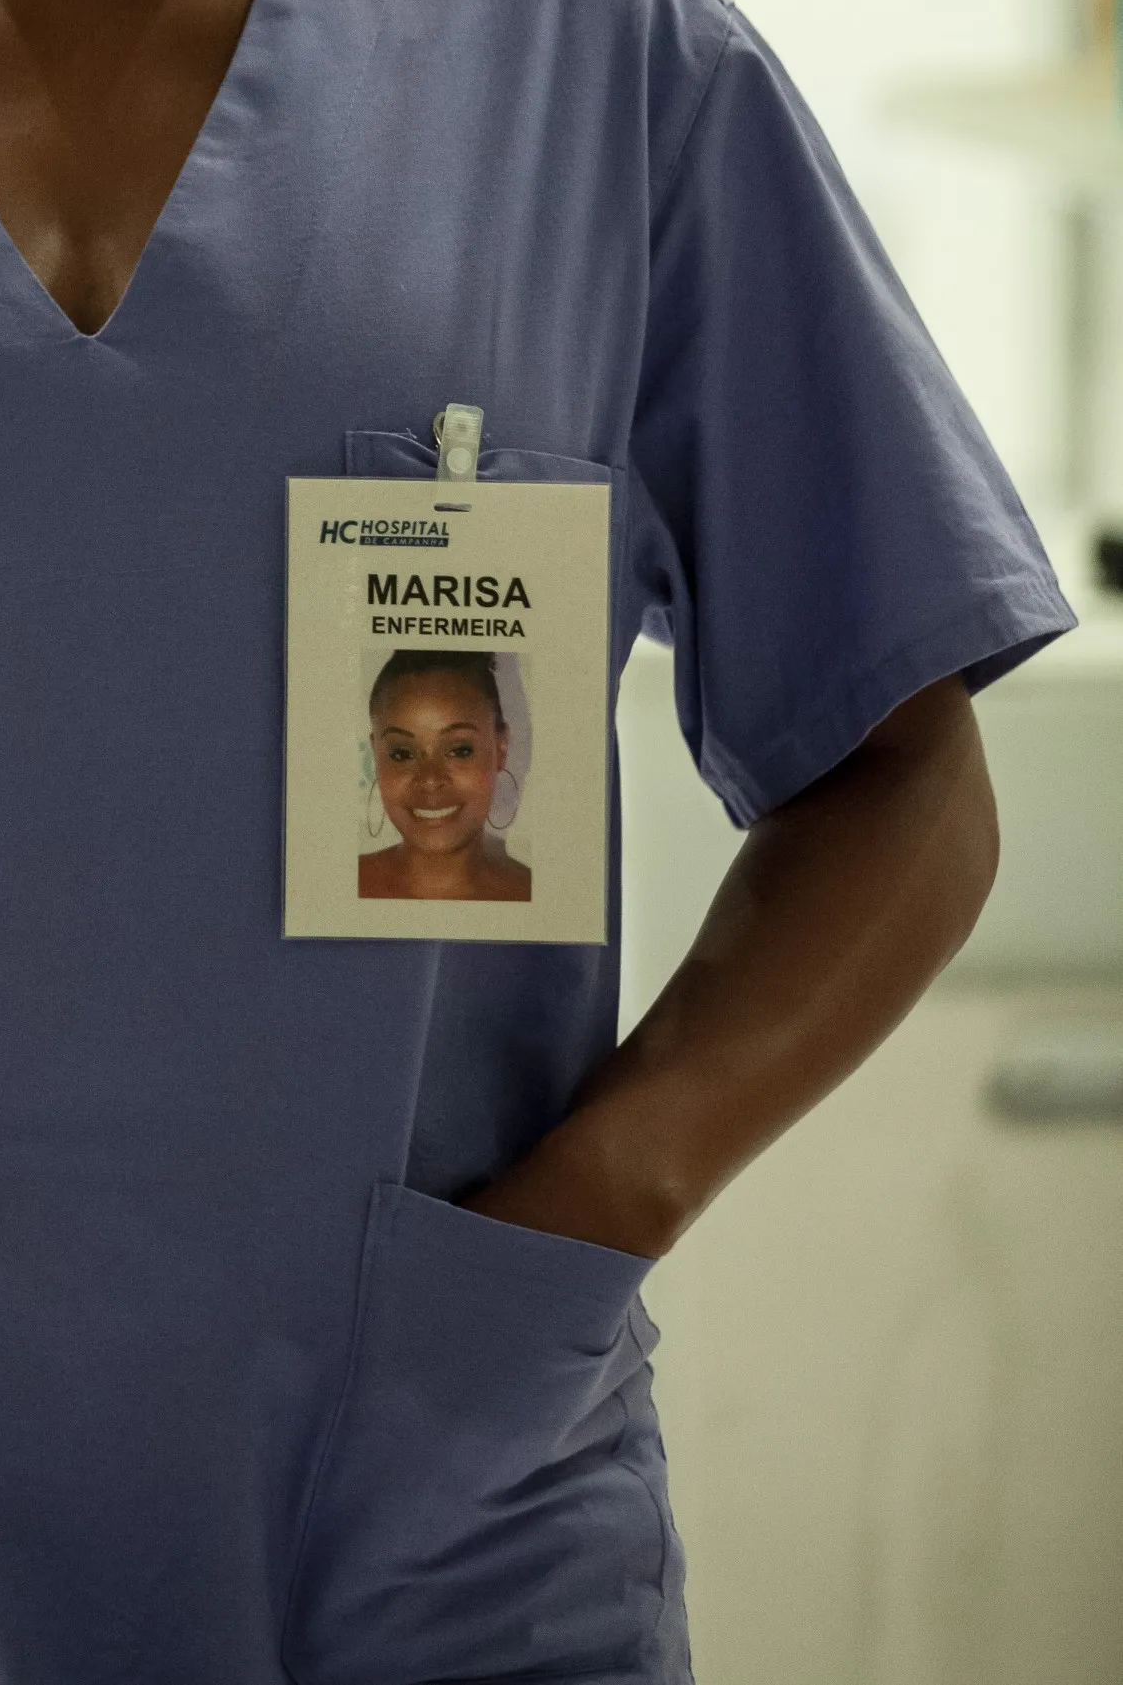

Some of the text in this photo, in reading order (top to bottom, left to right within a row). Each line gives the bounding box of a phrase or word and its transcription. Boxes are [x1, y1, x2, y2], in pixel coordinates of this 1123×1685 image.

[320, 520, 450, 544] HC HOSPITAL
[367, 573, 531, 608] MARISA
[371, 616, 525, 637] ENFERMEIRA
